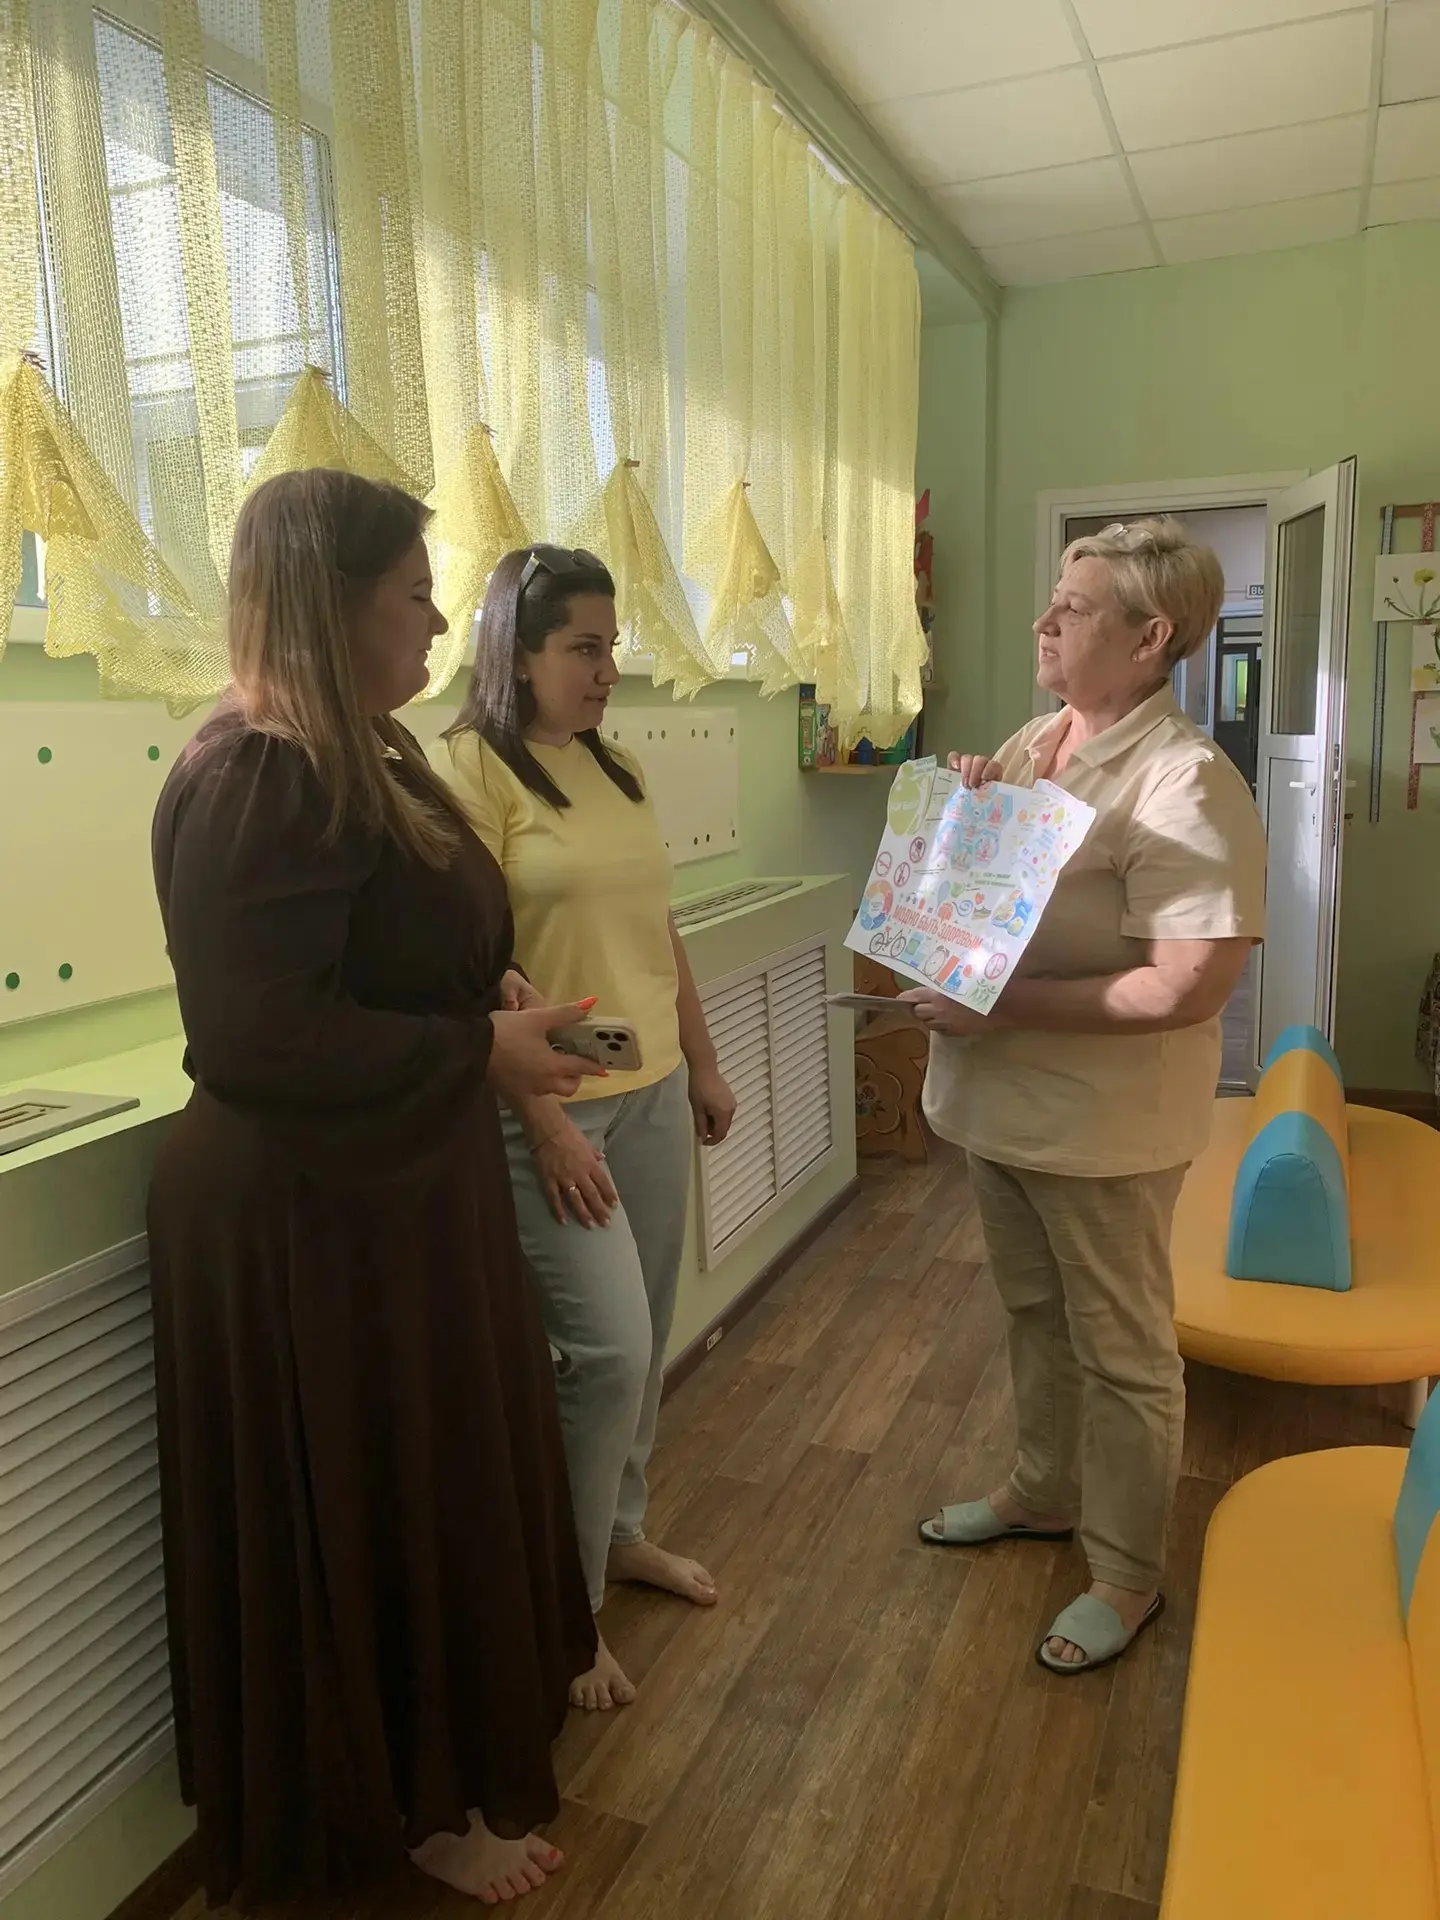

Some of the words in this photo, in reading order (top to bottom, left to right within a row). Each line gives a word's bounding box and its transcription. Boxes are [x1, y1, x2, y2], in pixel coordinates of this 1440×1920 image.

[1251, 586, 1264, 595] ВЫ
[917, 915, 939, 935] БЫТЬ
[937, 922, 984, 951] ЗДОРОВЫМ
